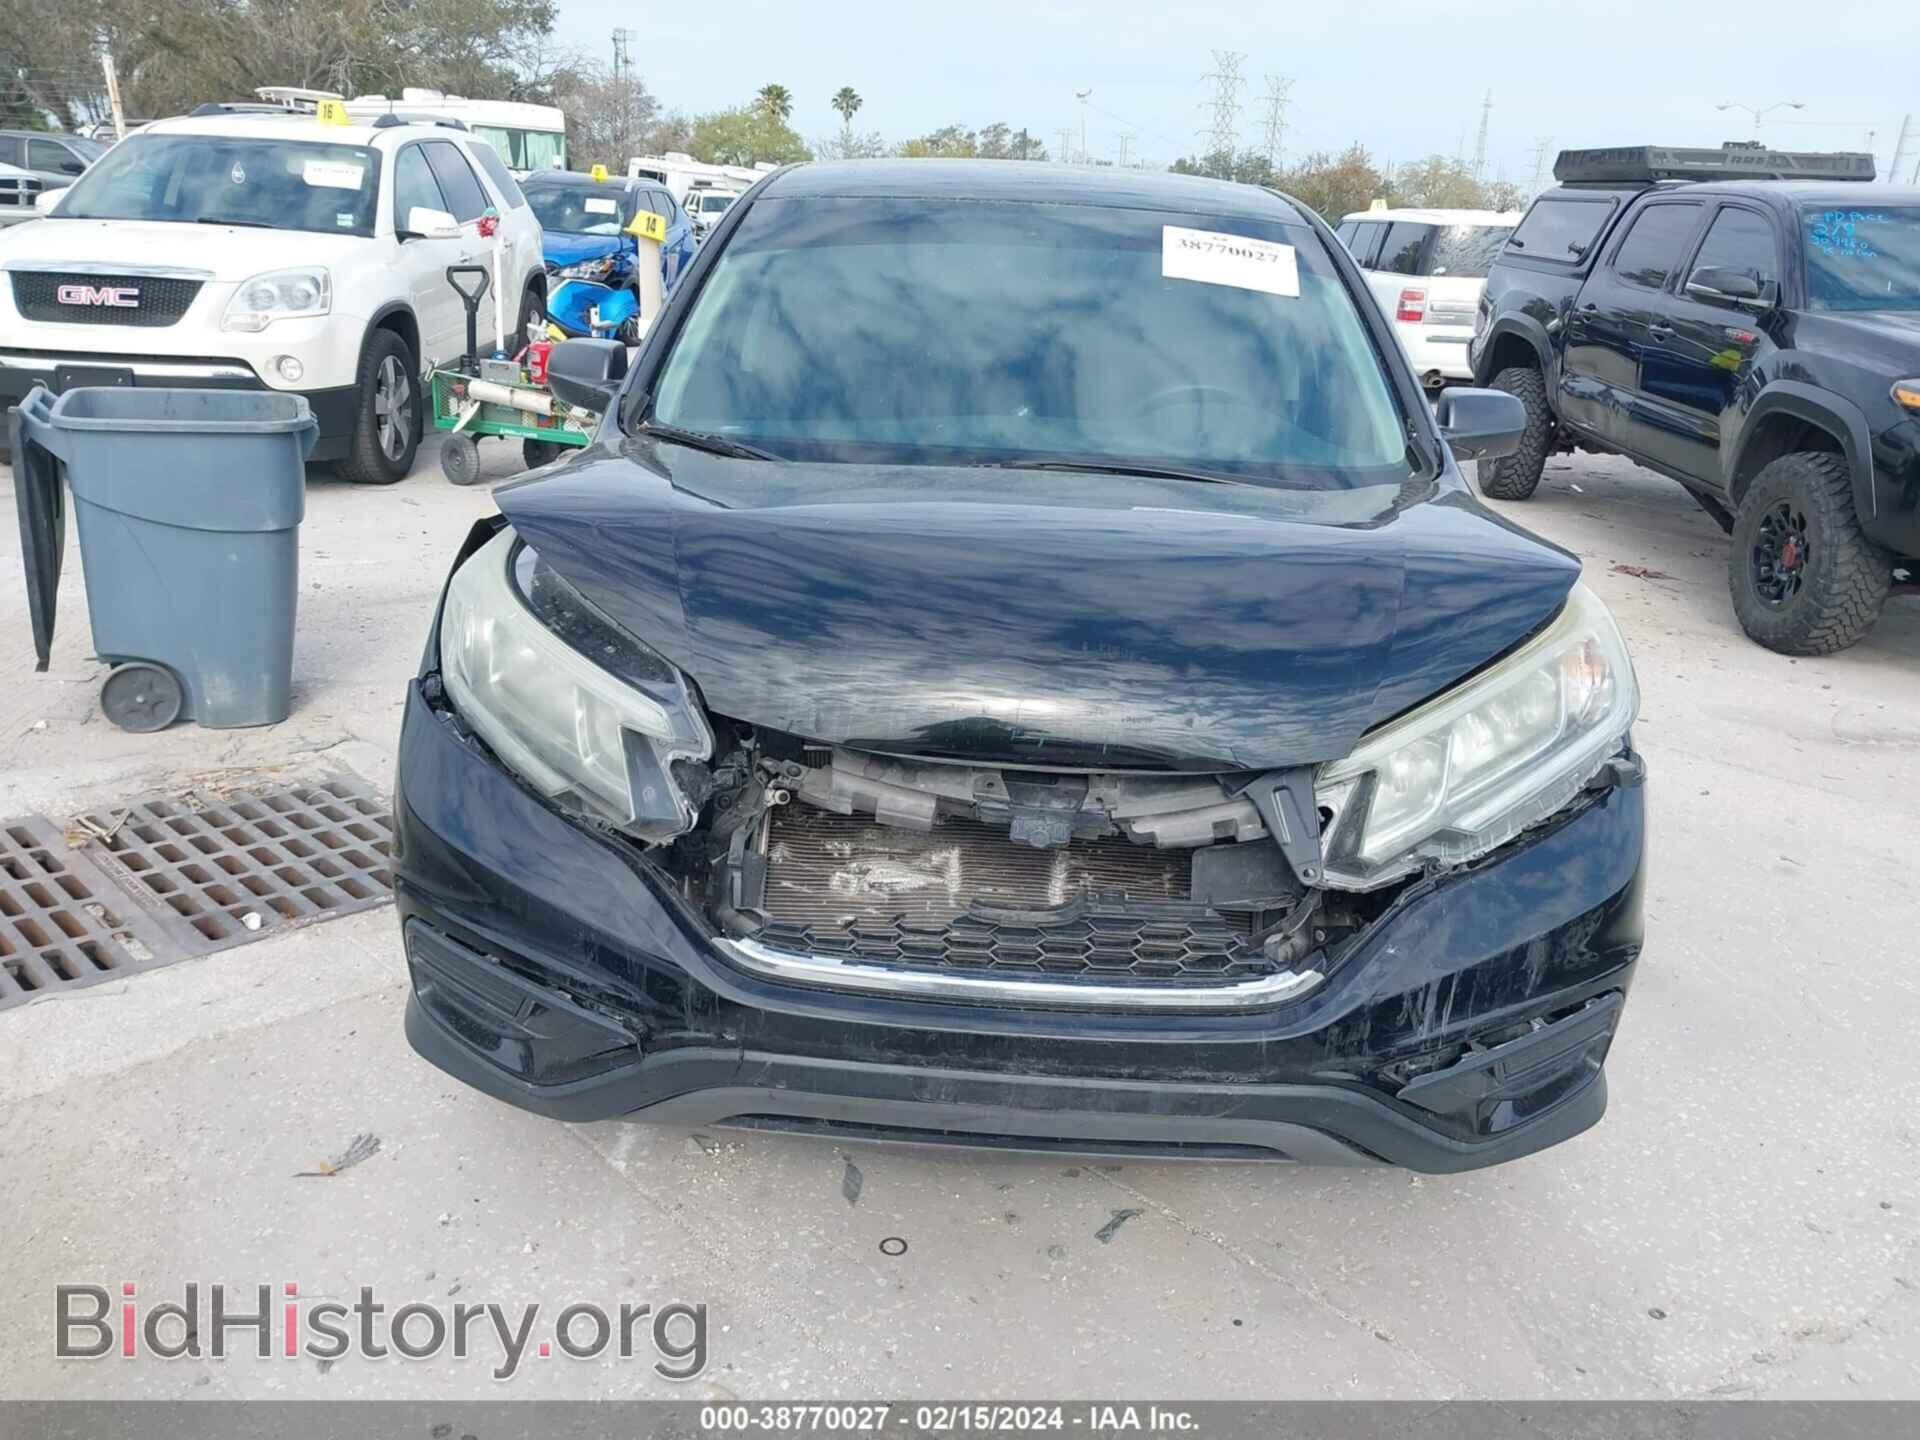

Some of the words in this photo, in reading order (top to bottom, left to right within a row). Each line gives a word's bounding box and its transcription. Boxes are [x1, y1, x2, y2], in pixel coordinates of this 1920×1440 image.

[323, 103, 334, 120] 16
[646, 216, 657, 233] 14
[1179, 239, 1279, 263] 38770027
[58, 285, 139, 307] GMC
